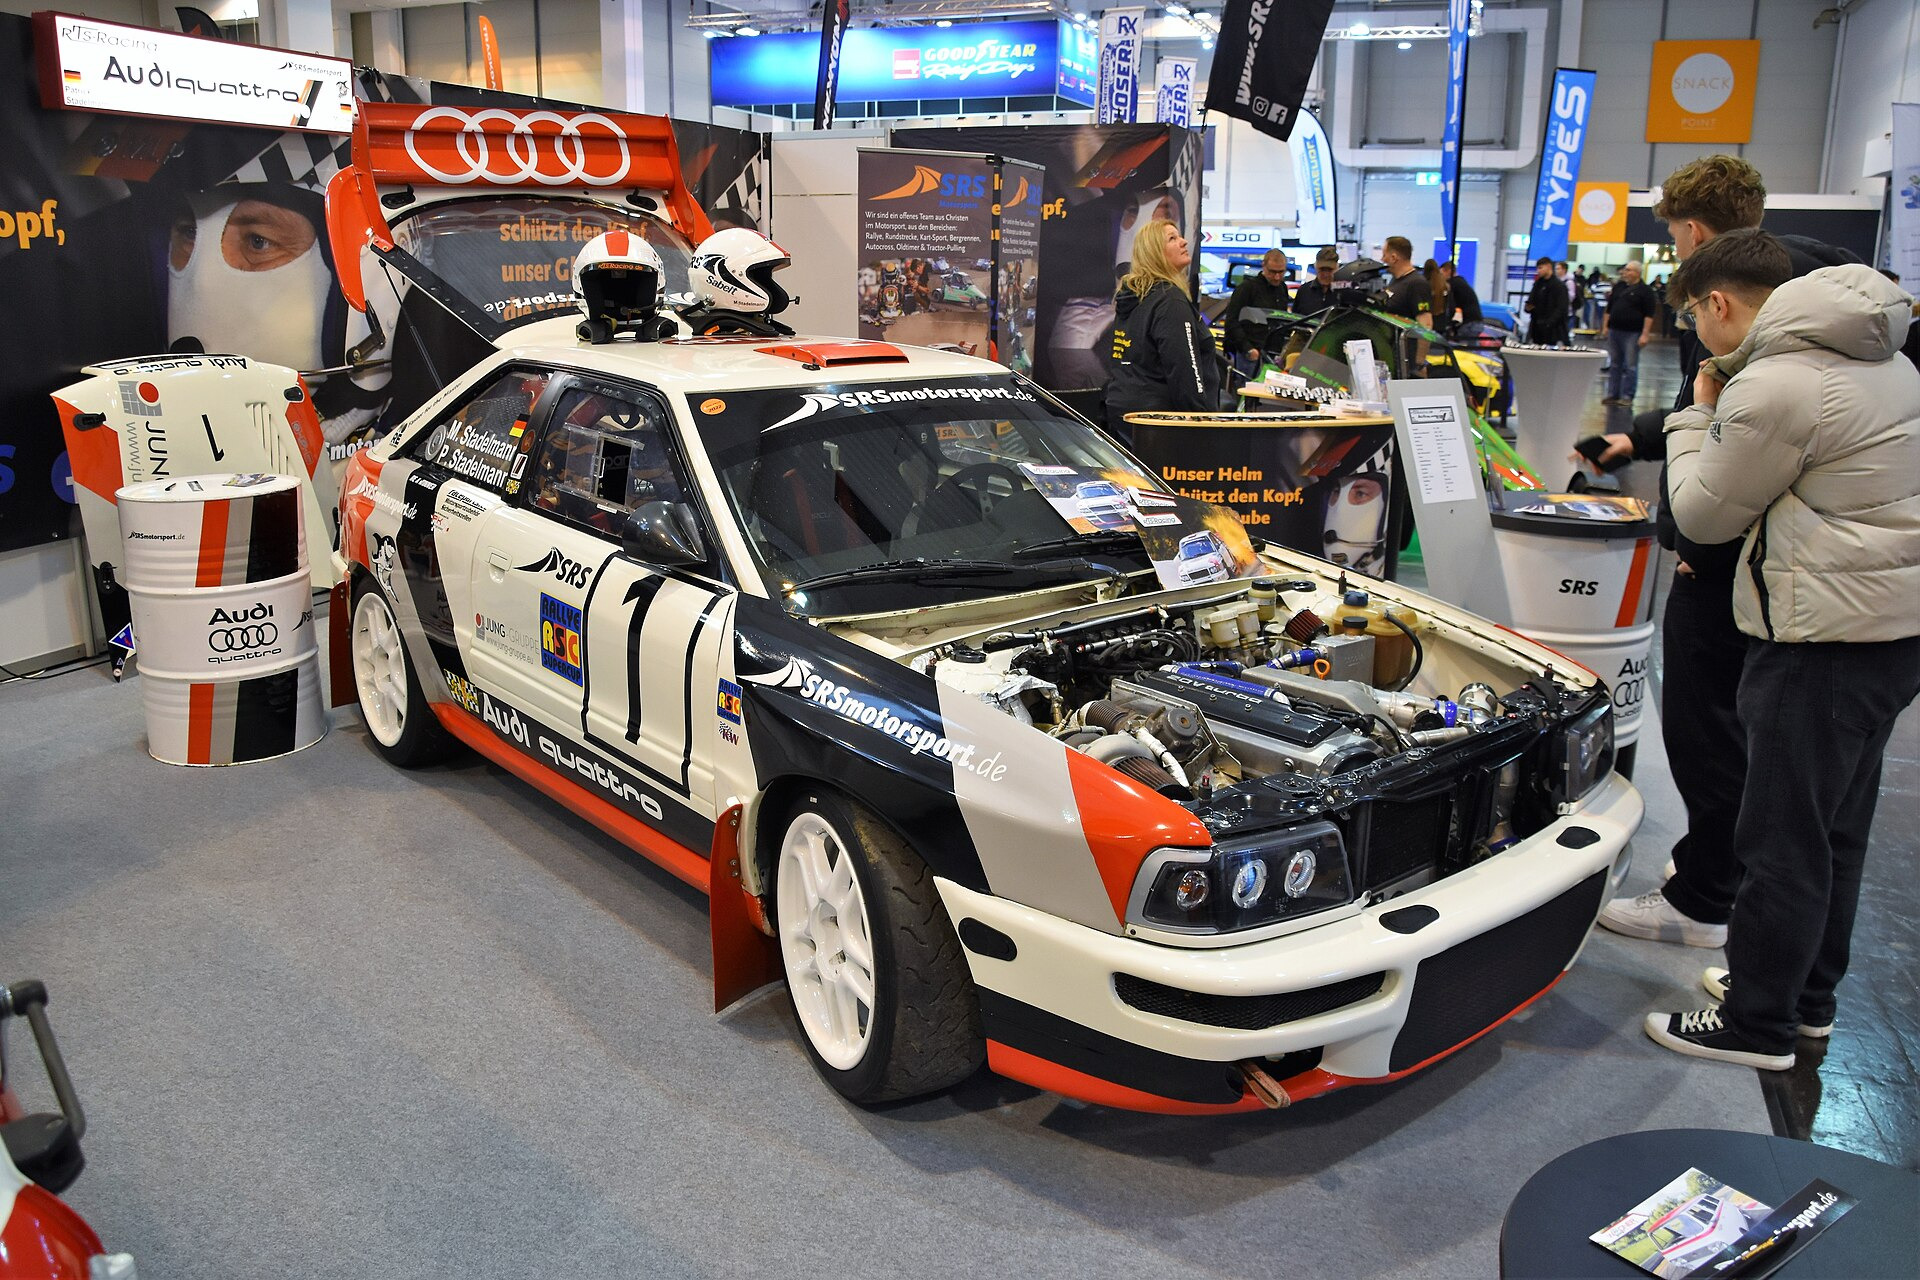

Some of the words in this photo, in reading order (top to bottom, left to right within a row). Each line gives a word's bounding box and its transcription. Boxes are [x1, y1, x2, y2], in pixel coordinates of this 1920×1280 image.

[923, 40, 1037, 63] GOODYEAR
[1674, 77, 1731, 90] SNACK
[940, 172, 987, 198] SRS
[864, 211, 877, 219] Wir
[877, 211, 889, 219] sind
[889, 212, 899, 220] ein
[899, 211, 919, 220] offenes
[945, 213, 969, 222] Christen
[874, 222, 907, 231] Motorsport,
[918, 223, 929, 231] den
[929, 223, 958, 231] Bereichen:
[500, 215, 567, 242] schützt
[865, 232, 884, 241] Rallye,
[885, 232, 919, 241] Rundstrecke,
[919, 234, 948, 243] Kart-Sport,
[949, 234, 982, 243] Bergrennen,
[1222, 233, 1261, 242] 500
[865, 243, 896, 251] Autocross,
[896, 243, 920, 251] Oldtimer
[926, 243, 966, 254] Tractor-Pulling
[502, 260, 552, 283] unser
[706, 275, 738, 297] Sabelt
[208, 357, 248, 370] Audi
[842, 386, 1037, 408] SRSmotorsport.de
[201, 414, 225, 462] 1
[447, 419, 463, 442] M.
[146, 420, 170, 481] JUN
[437, 444, 450, 466] P.
[1162, 466, 1214, 481] Unser
[1218, 466, 1263, 481] Helm
[1228, 488, 1251, 503] den
[1263, 487, 1304, 507] Kopf,
[134, 531, 185, 542] SRSmotorsport.de
[556, 558, 593, 590] SRS
[1558, 579, 1599, 596] SRS
[208, 602, 274, 626] Audi
[541, 595, 581, 632] RALLYE
[542, 619, 579, 666] RSC
[207, 647, 282, 665] quattro
[542, 652, 581, 682] SUPERCUP
[621, 573, 667, 746] 1
[718, 691, 740, 716] RSC
[799, 673, 1007, 782] SRSmotorsport.de
[482, 691, 531, 749] Audi
[538, 734, 664, 822] quattro
